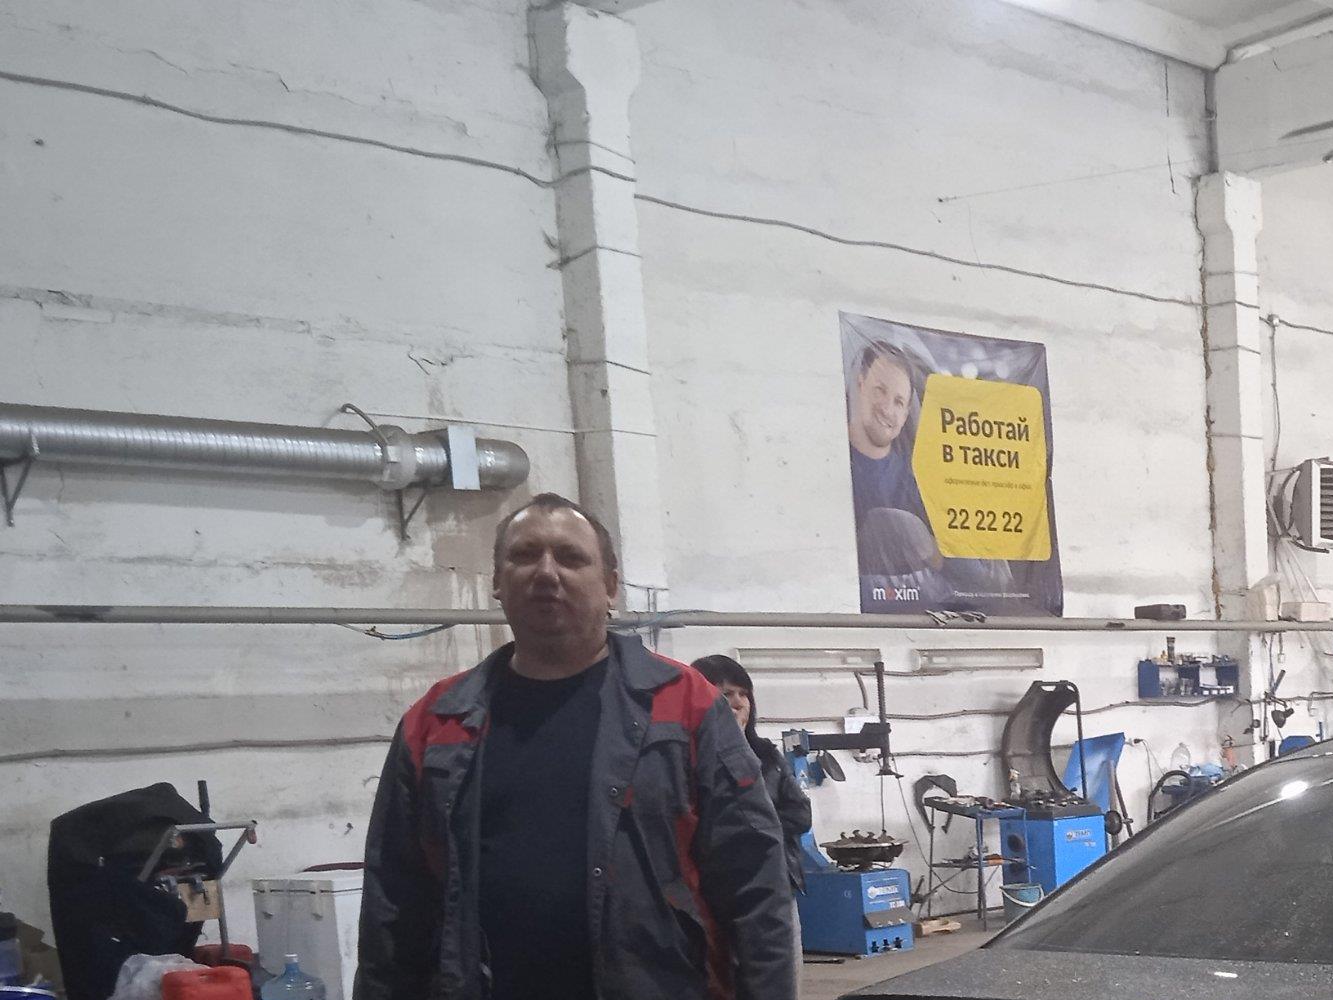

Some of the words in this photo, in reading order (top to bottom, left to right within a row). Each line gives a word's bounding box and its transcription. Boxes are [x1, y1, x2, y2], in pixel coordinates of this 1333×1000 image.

[941, 408, 1029, 442] Работай
[942, 444, 954, 463] в
[959, 445, 1020, 469] такси
[947, 508, 970, 530] 22
[975, 510, 997, 531] 22
[1002, 511, 1023, 533] 22
